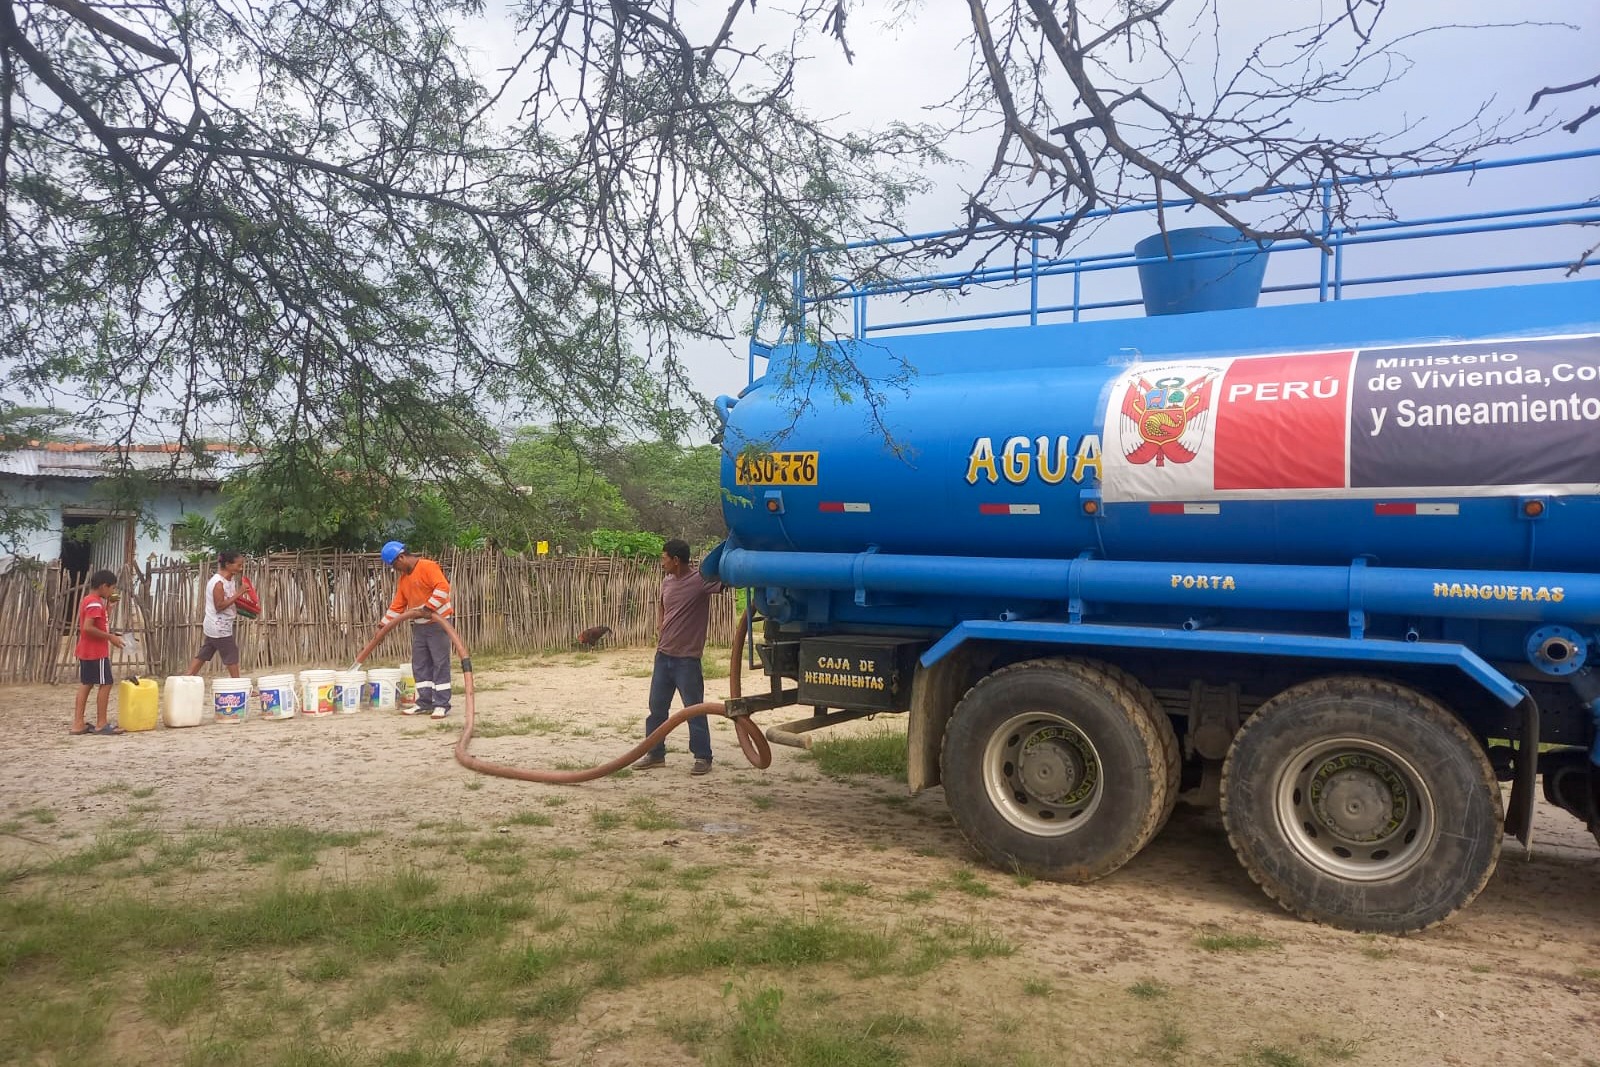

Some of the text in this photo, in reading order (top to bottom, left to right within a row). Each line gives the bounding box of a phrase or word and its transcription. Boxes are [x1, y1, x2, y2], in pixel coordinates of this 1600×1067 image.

[1376, 352, 1518, 369] Ministerio
[1228, 376, 1339, 403] PERÚ
[1368, 373, 1402, 391] de
[1370, 393, 1600, 436] y Saneamiento
[965, 434, 1102, 484] AGUA
[1171, 575, 1565, 602] PORTA MANGUERAS
[817, 656, 875, 672] CAJA DE
[804, 671, 884, 690] HERRAMIENTAS
